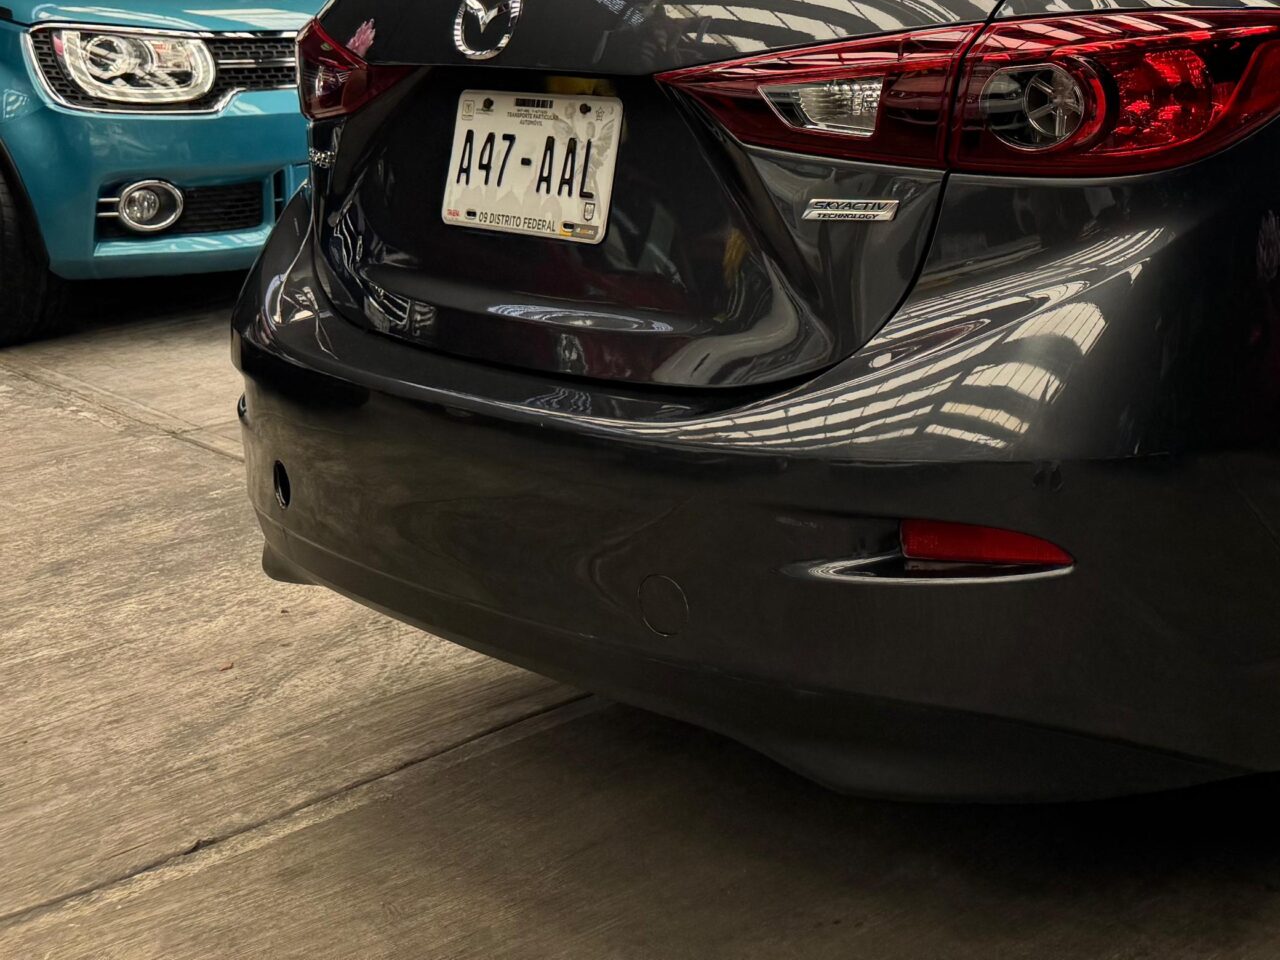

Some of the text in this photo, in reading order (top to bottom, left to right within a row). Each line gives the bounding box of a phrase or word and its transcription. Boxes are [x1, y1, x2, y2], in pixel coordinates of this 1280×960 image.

[457, 130, 595, 198] A47-AAL
[813, 201, 889, 210] SKYACTIV
[479, 212, 556, 232] 09 DISTRITO FEDERAL
